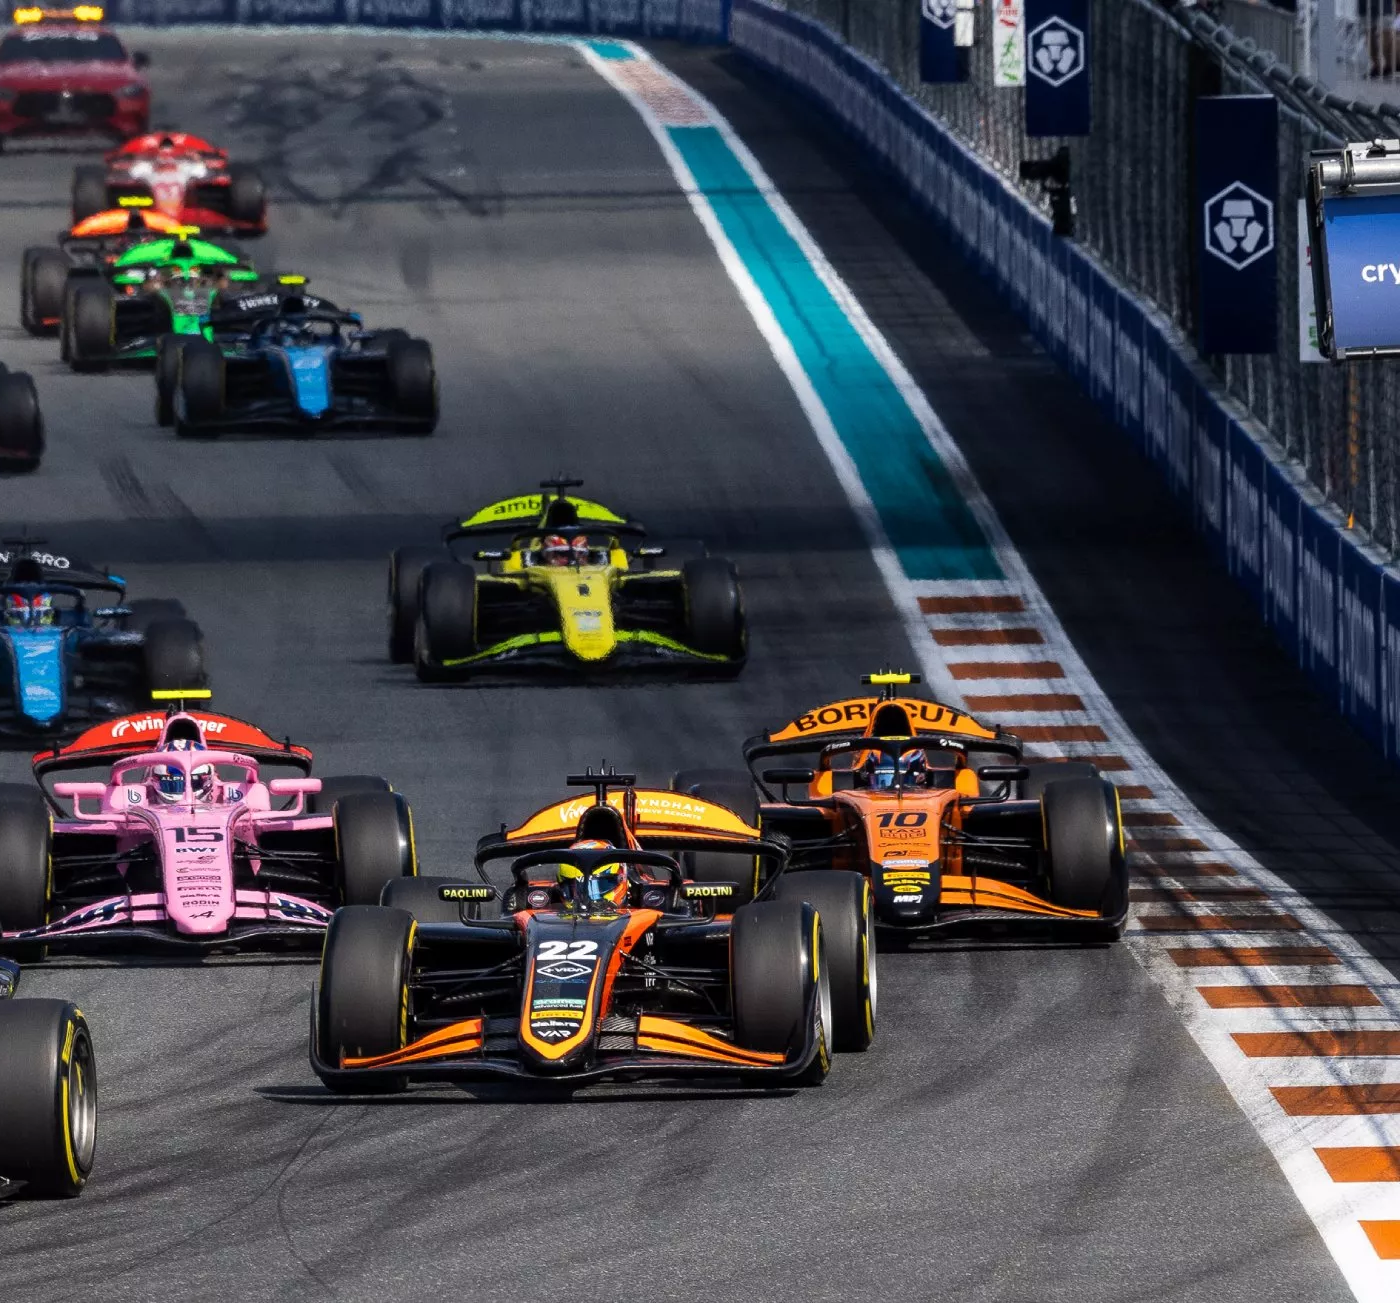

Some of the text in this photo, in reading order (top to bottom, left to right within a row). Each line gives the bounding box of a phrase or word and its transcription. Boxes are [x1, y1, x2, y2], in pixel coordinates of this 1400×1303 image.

[1362, 263, 1400, 284] cry
[493, 499, 582, 515] ambr
[639, 799, 705, 813] YNDHAM
[876, 812, 928, 828] 10
[166, 827, 224, 843] 15
[443, 889, 487, 898] PAOLINI
[686, 886, 732, 897] PAOLINI
[536, 940, 598, 961] 22
